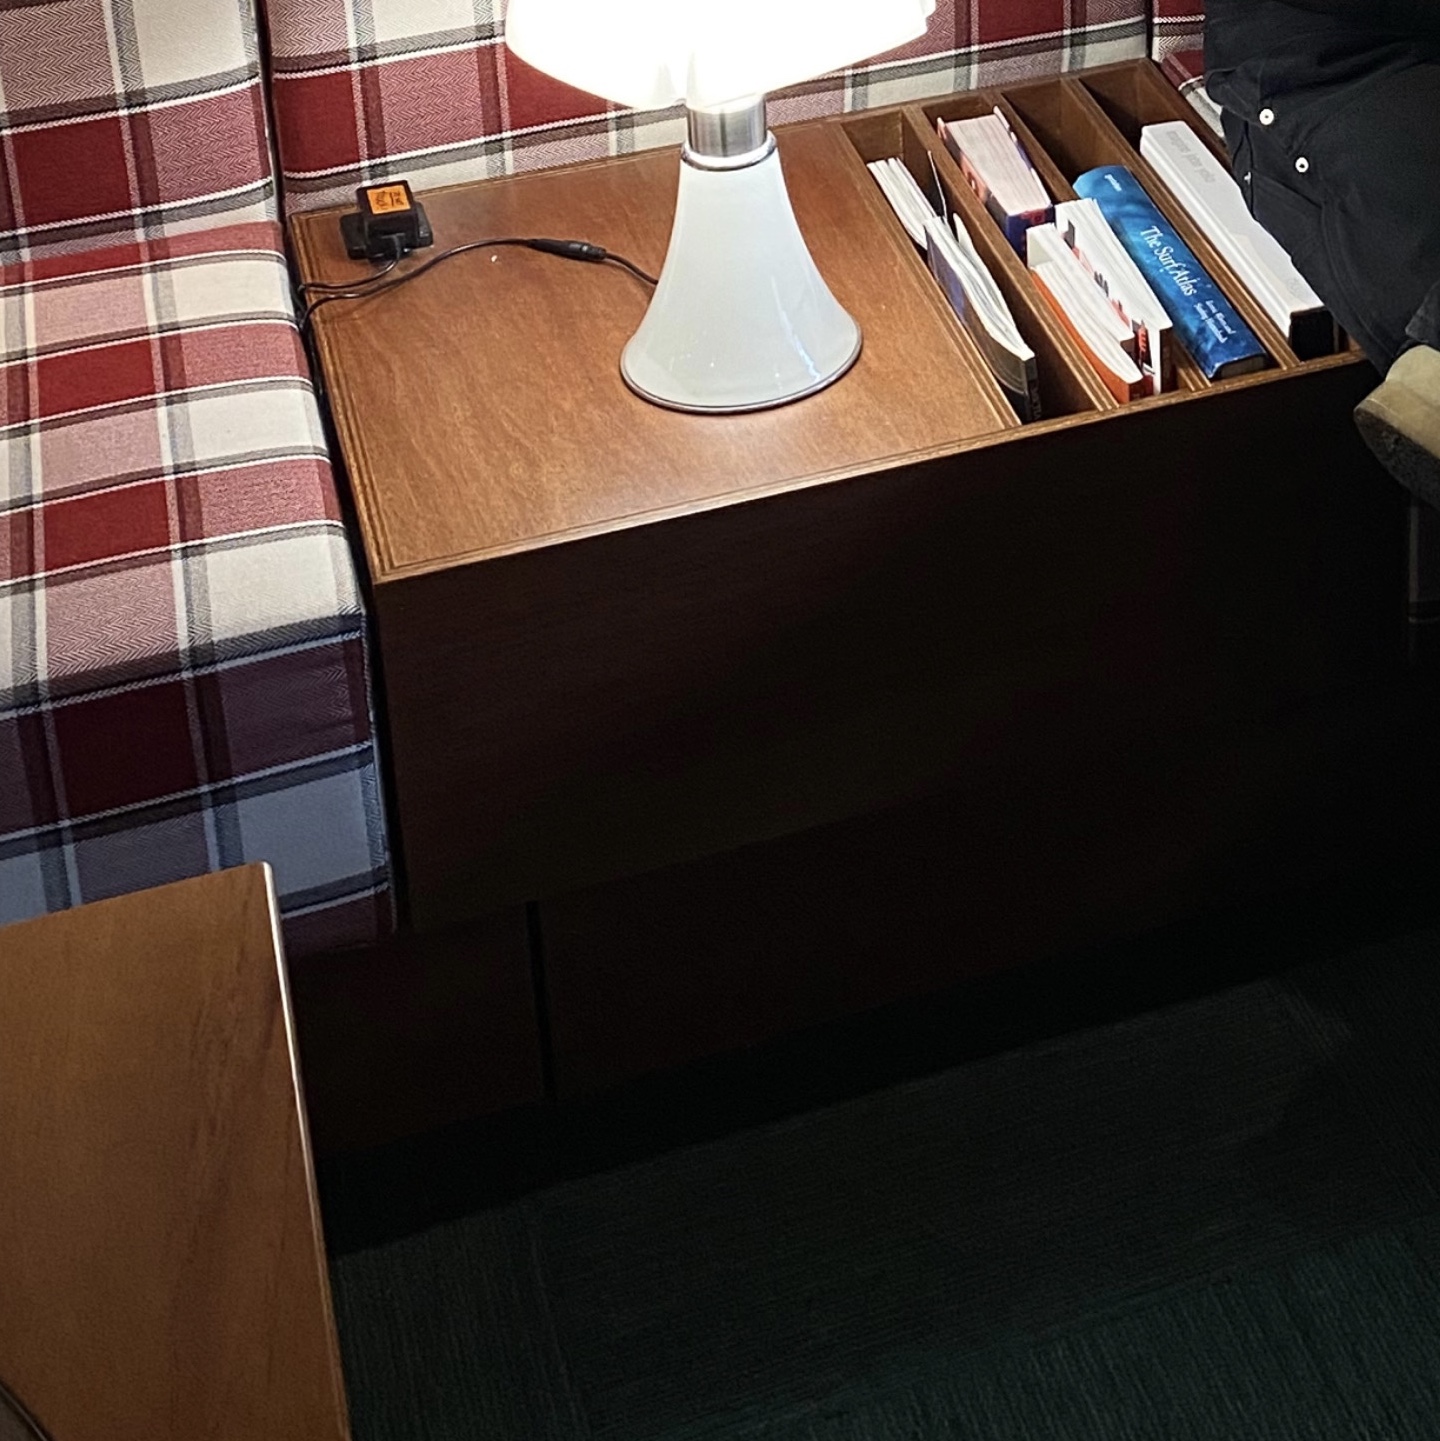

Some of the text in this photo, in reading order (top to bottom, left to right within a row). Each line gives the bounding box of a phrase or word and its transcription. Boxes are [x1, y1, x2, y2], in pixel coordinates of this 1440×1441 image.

[1140, 225, 1200, 297] The Surf Atlas
